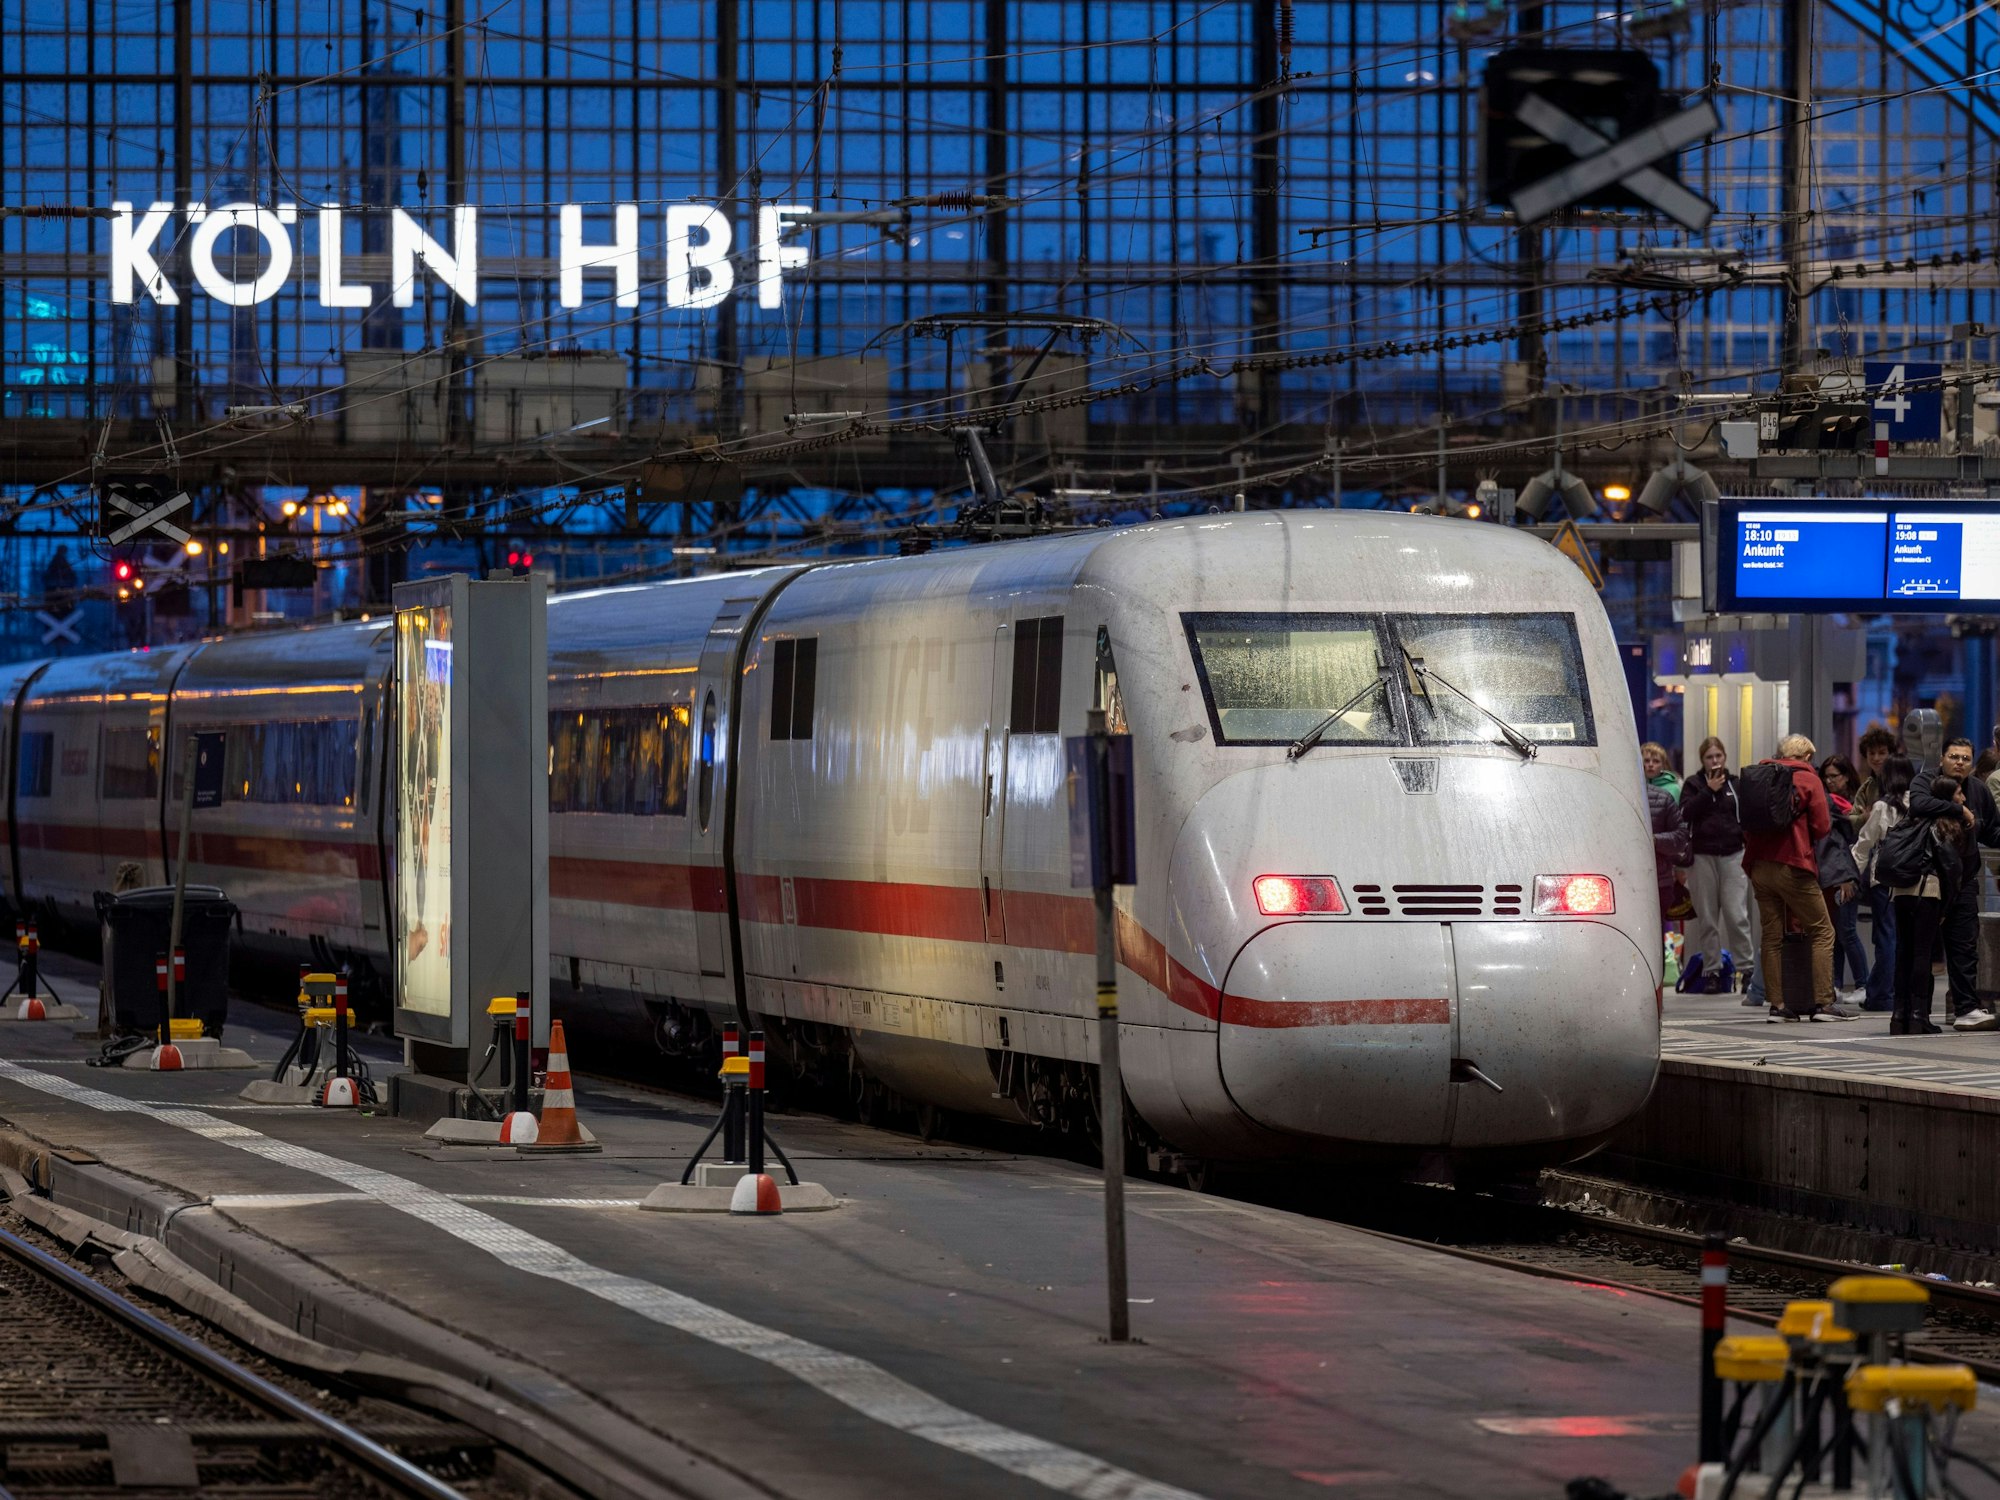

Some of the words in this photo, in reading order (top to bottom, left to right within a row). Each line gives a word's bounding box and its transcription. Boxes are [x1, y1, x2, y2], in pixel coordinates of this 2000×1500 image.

[110, 202, 477, 308] KÖLN
[560, 203, 812, 309] HBF
[1874, 364, 1911, 423] 4
[1744, 529, 1772, 541] 18:10
[1895, 530, 1917, 540] 19:08
[1743, 543, 1784, 556] Ankunft
[1894, 544, 1922, 554] Ankunft
